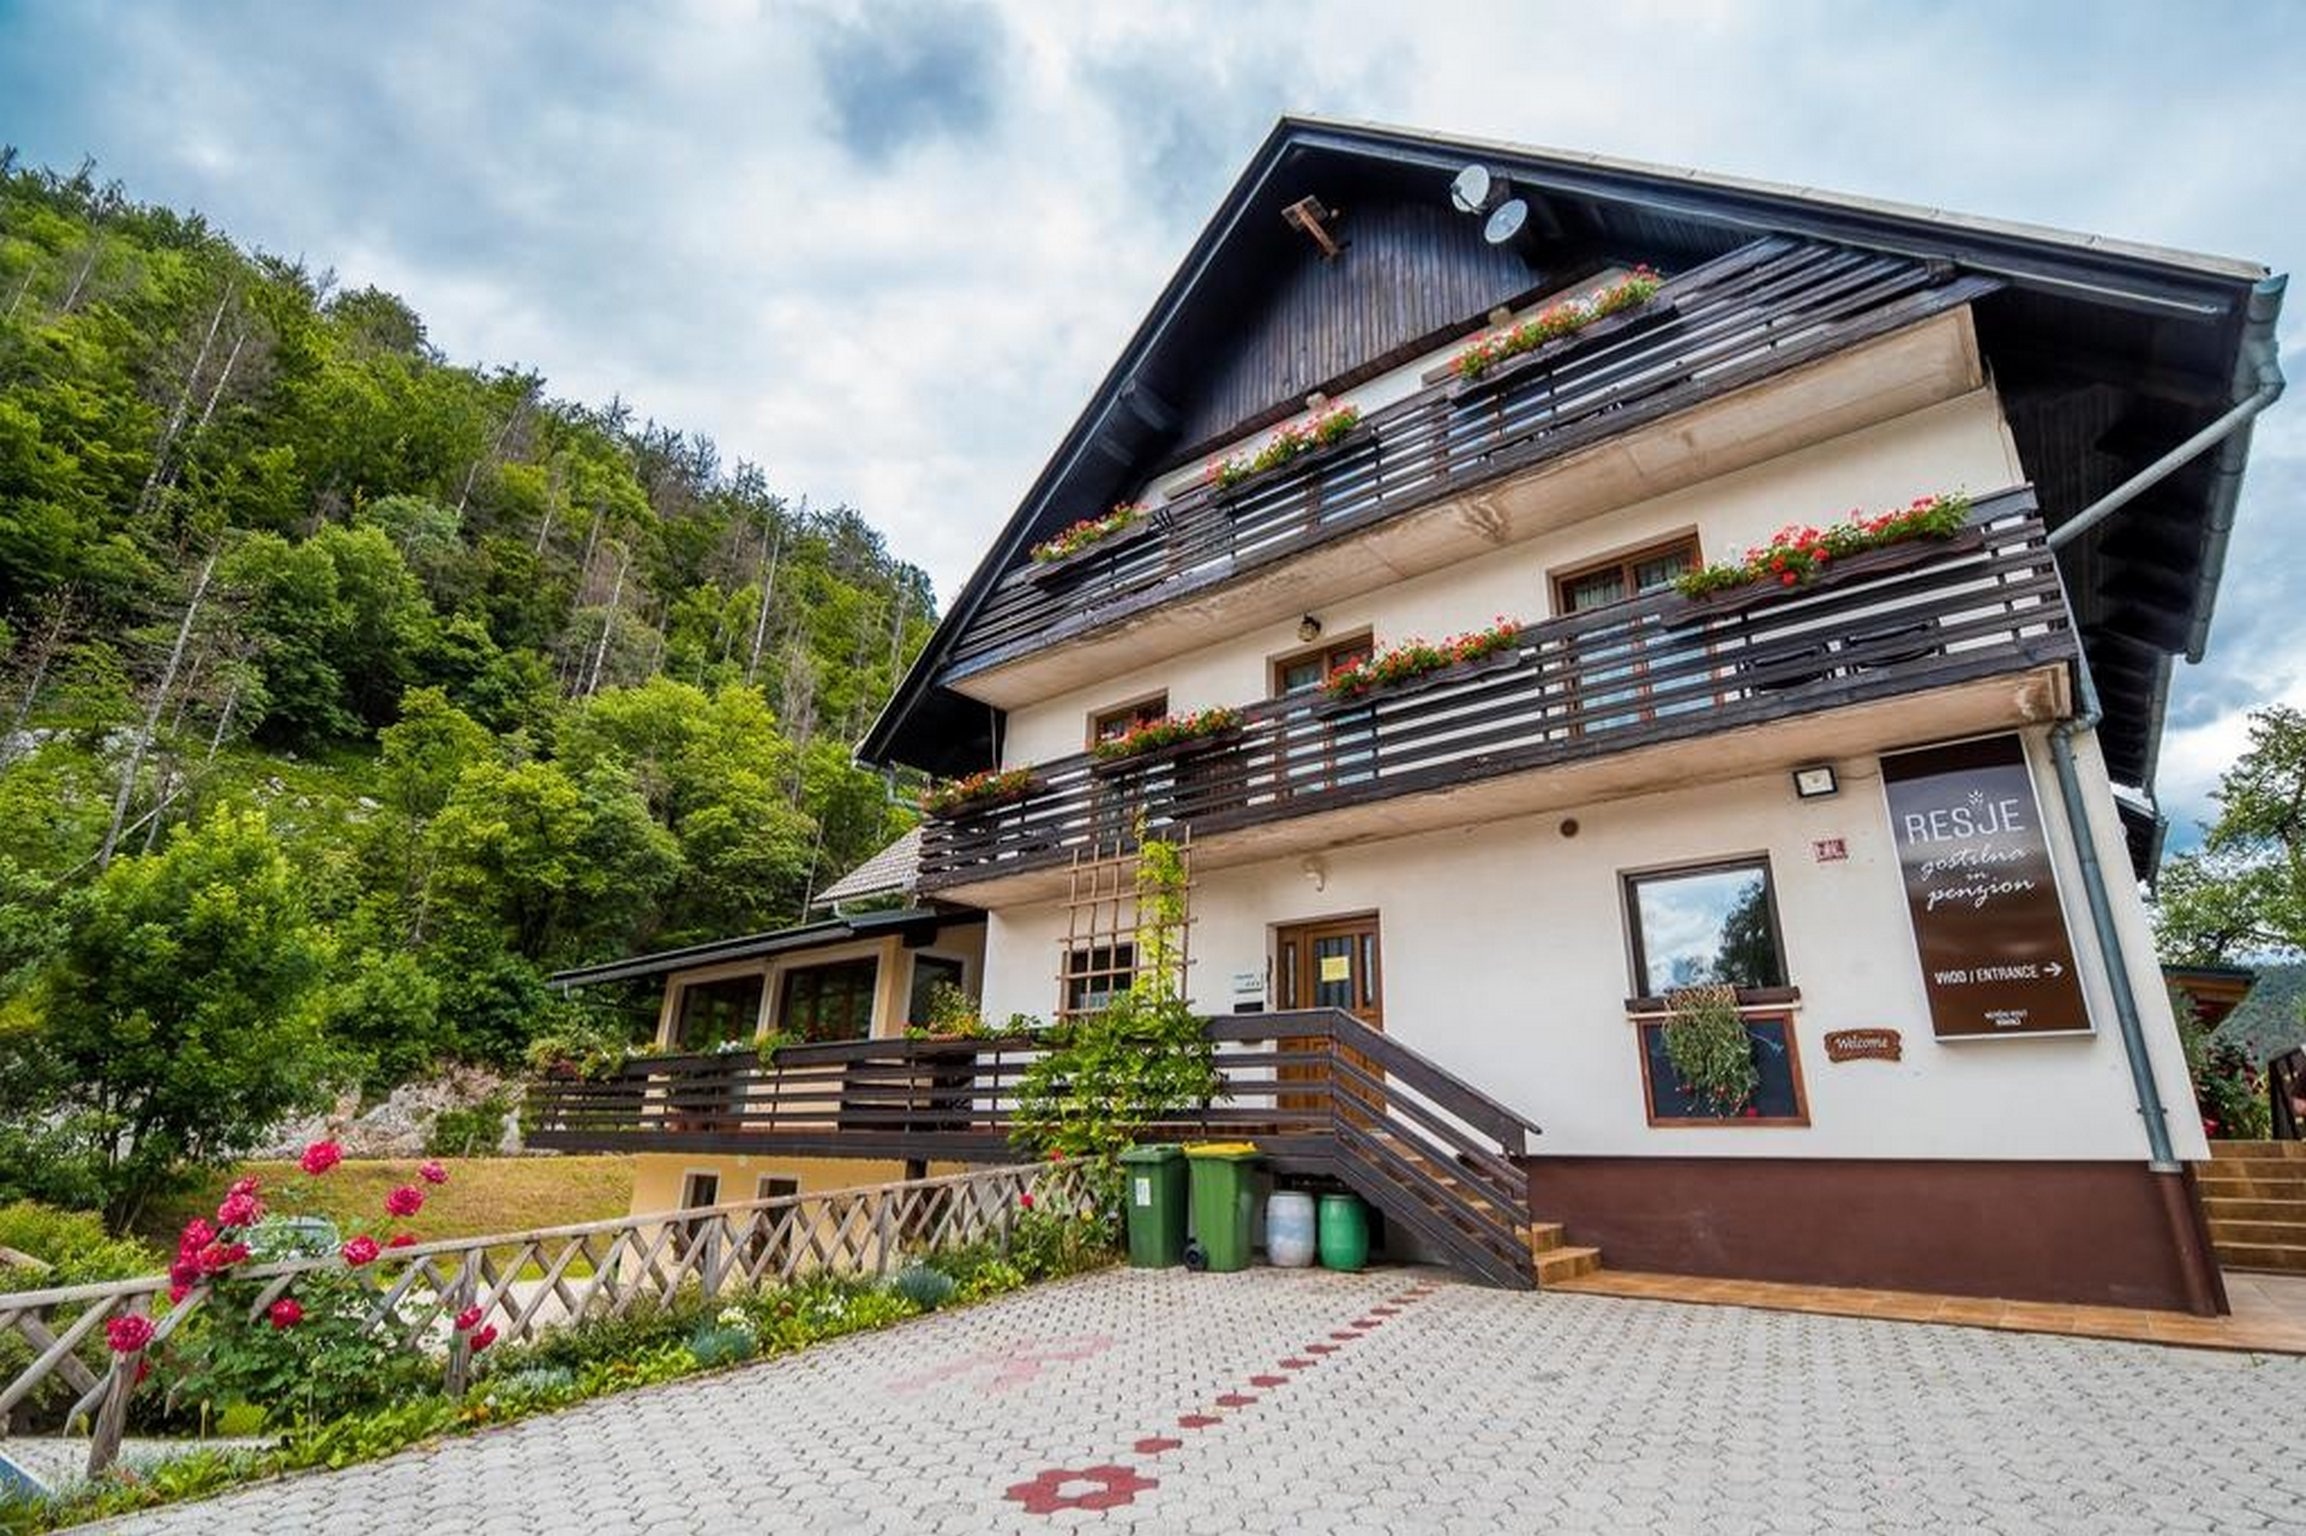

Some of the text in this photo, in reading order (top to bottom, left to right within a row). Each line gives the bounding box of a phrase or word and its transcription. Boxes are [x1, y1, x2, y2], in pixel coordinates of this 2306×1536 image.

[1905, 799, 2026, 845] RESJE
[1927, 876, 2035, 911] penzion
[1976, 964, 2040, 982] ENTRANCE
[1836, 1035, 1888, 1050] Welcome
